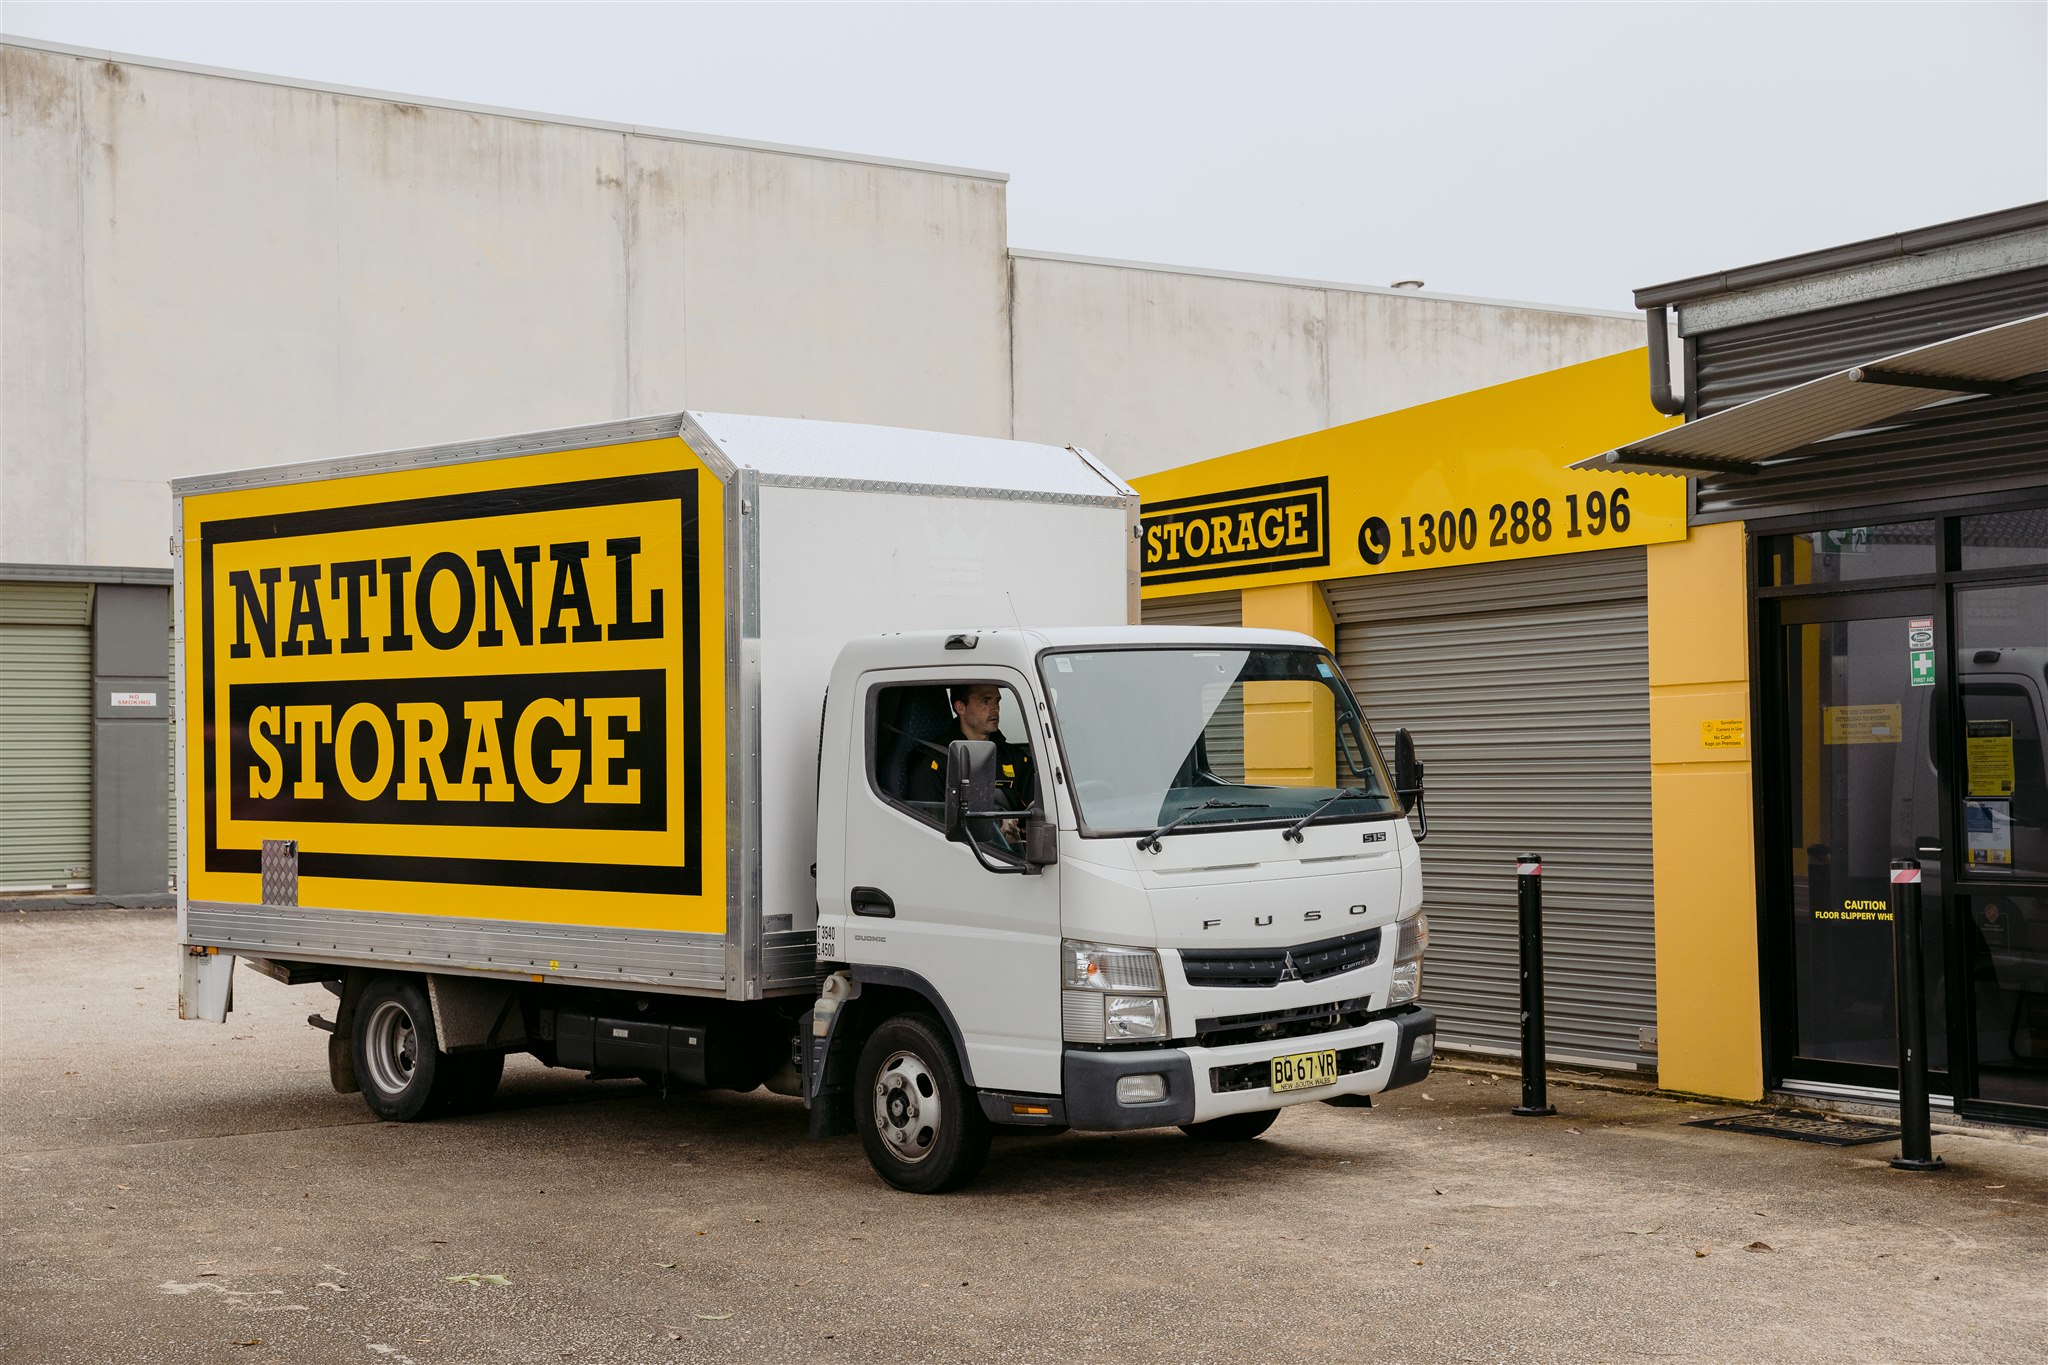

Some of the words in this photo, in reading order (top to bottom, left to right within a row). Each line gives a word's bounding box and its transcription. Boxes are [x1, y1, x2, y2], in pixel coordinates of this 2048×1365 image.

[1147, 504, 1308, 563] STORAGE
[1401, 507, 1477, 557] 1300
[1489, 498, 1552, 547] 288
[1566, 487, 1630, 538] 196
[230, 536, 664, 659] NATIONAL
[248, 697, 641, 804] STORAGE
[1203, 904, 1366, 930] FUSO
[1815, 911, 1840, 919] FLOOR
[1840, 912, 1876, 920] SLIPPERY
[1877, 912, 1894, 921] WHE
[1844, 900, 1887, 910] CAUTION
[821, 925, 836, 941] 3540
[1295, 1080, 1314, 1088] SOUTH
[1315, 1077, 1331, 1085] WALES
